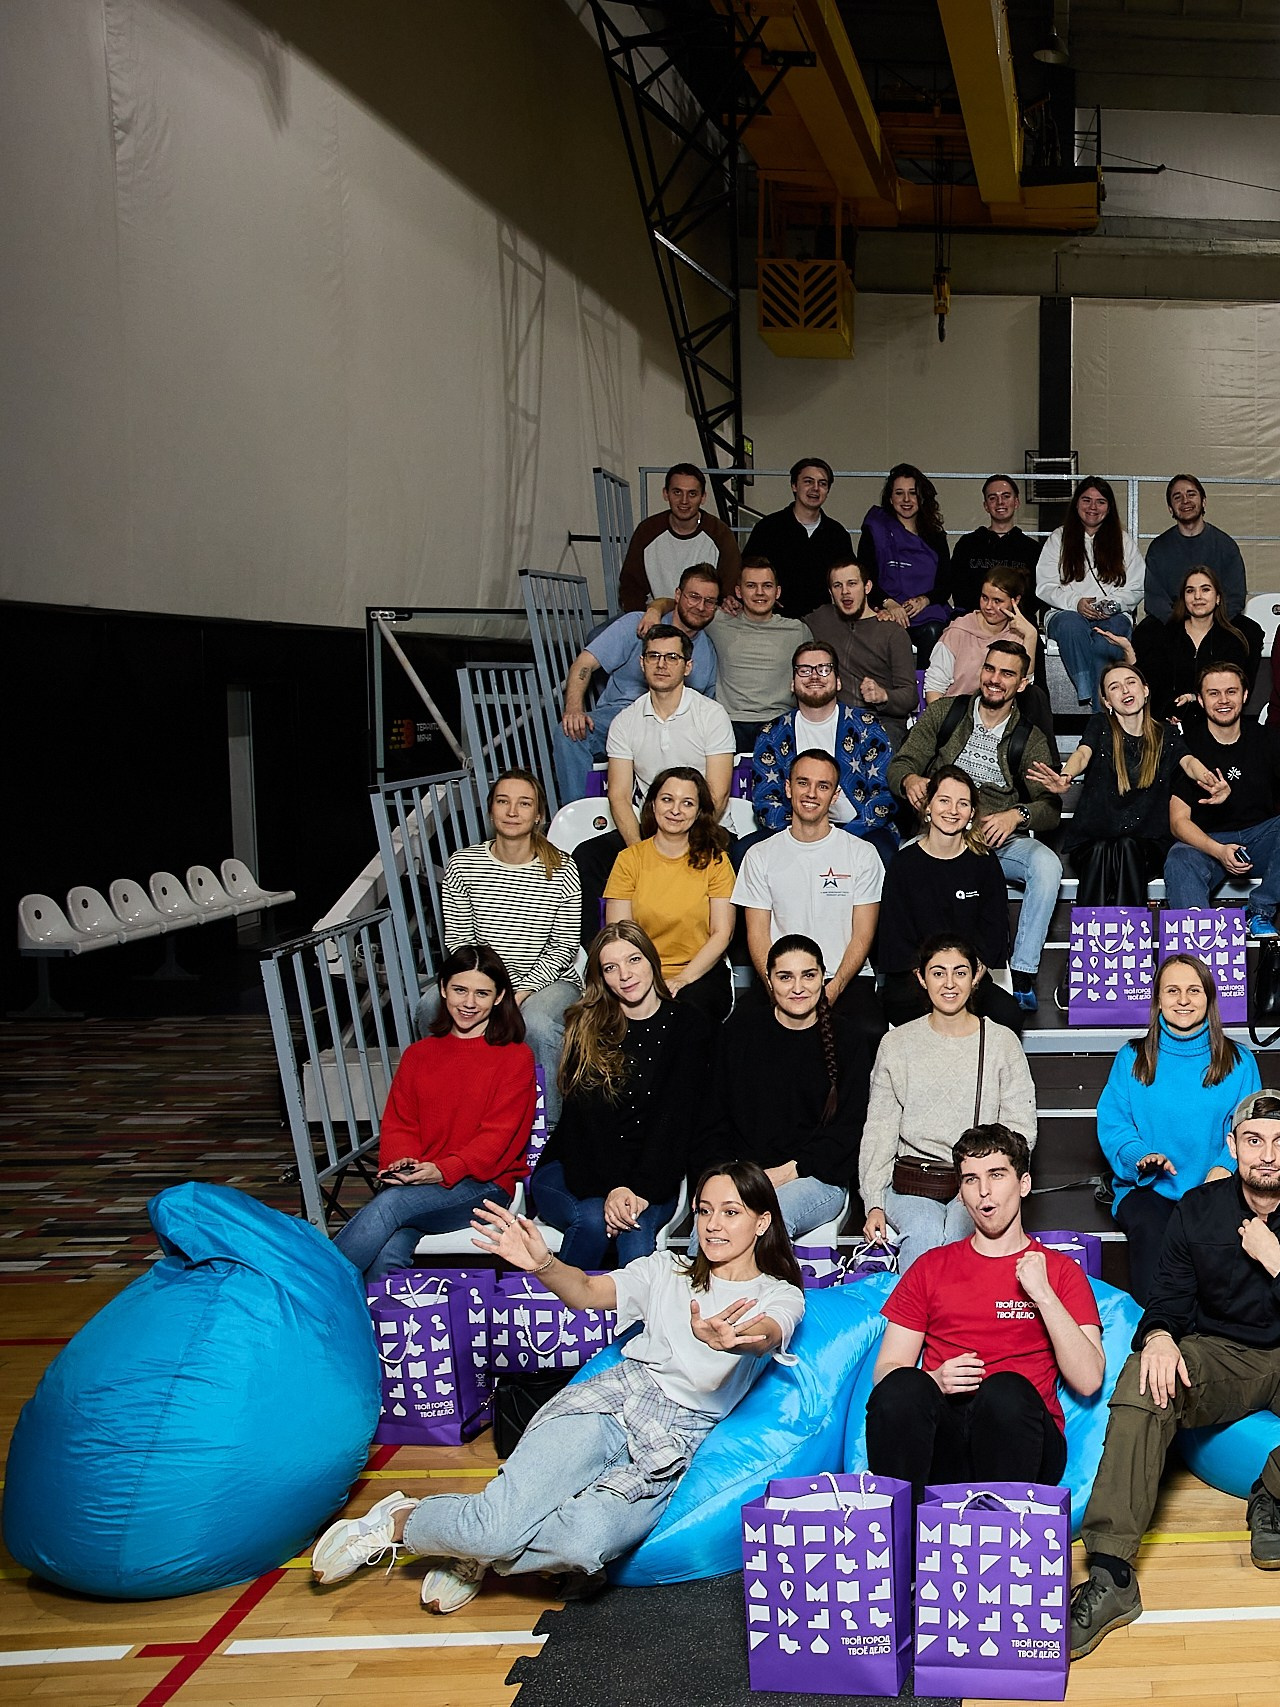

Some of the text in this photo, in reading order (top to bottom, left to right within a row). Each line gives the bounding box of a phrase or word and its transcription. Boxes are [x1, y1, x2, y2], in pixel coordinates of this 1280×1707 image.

[995, 1300, 1014, 1308] ТВОЙ
[996, 1310, 1035, 1320] ТВОЁ ДЕЛО
[841, 1634, 890, 1646] ТВОЙ ГОРОД
[1011, 1638, 1060, 1649] ТВОЙ ГОРОД
[847, 1645, 891, 1656] ТВОЁ ДЕЛО
[1018, 1648, 1061, 1660] ТВОЁ ДЕЛО
